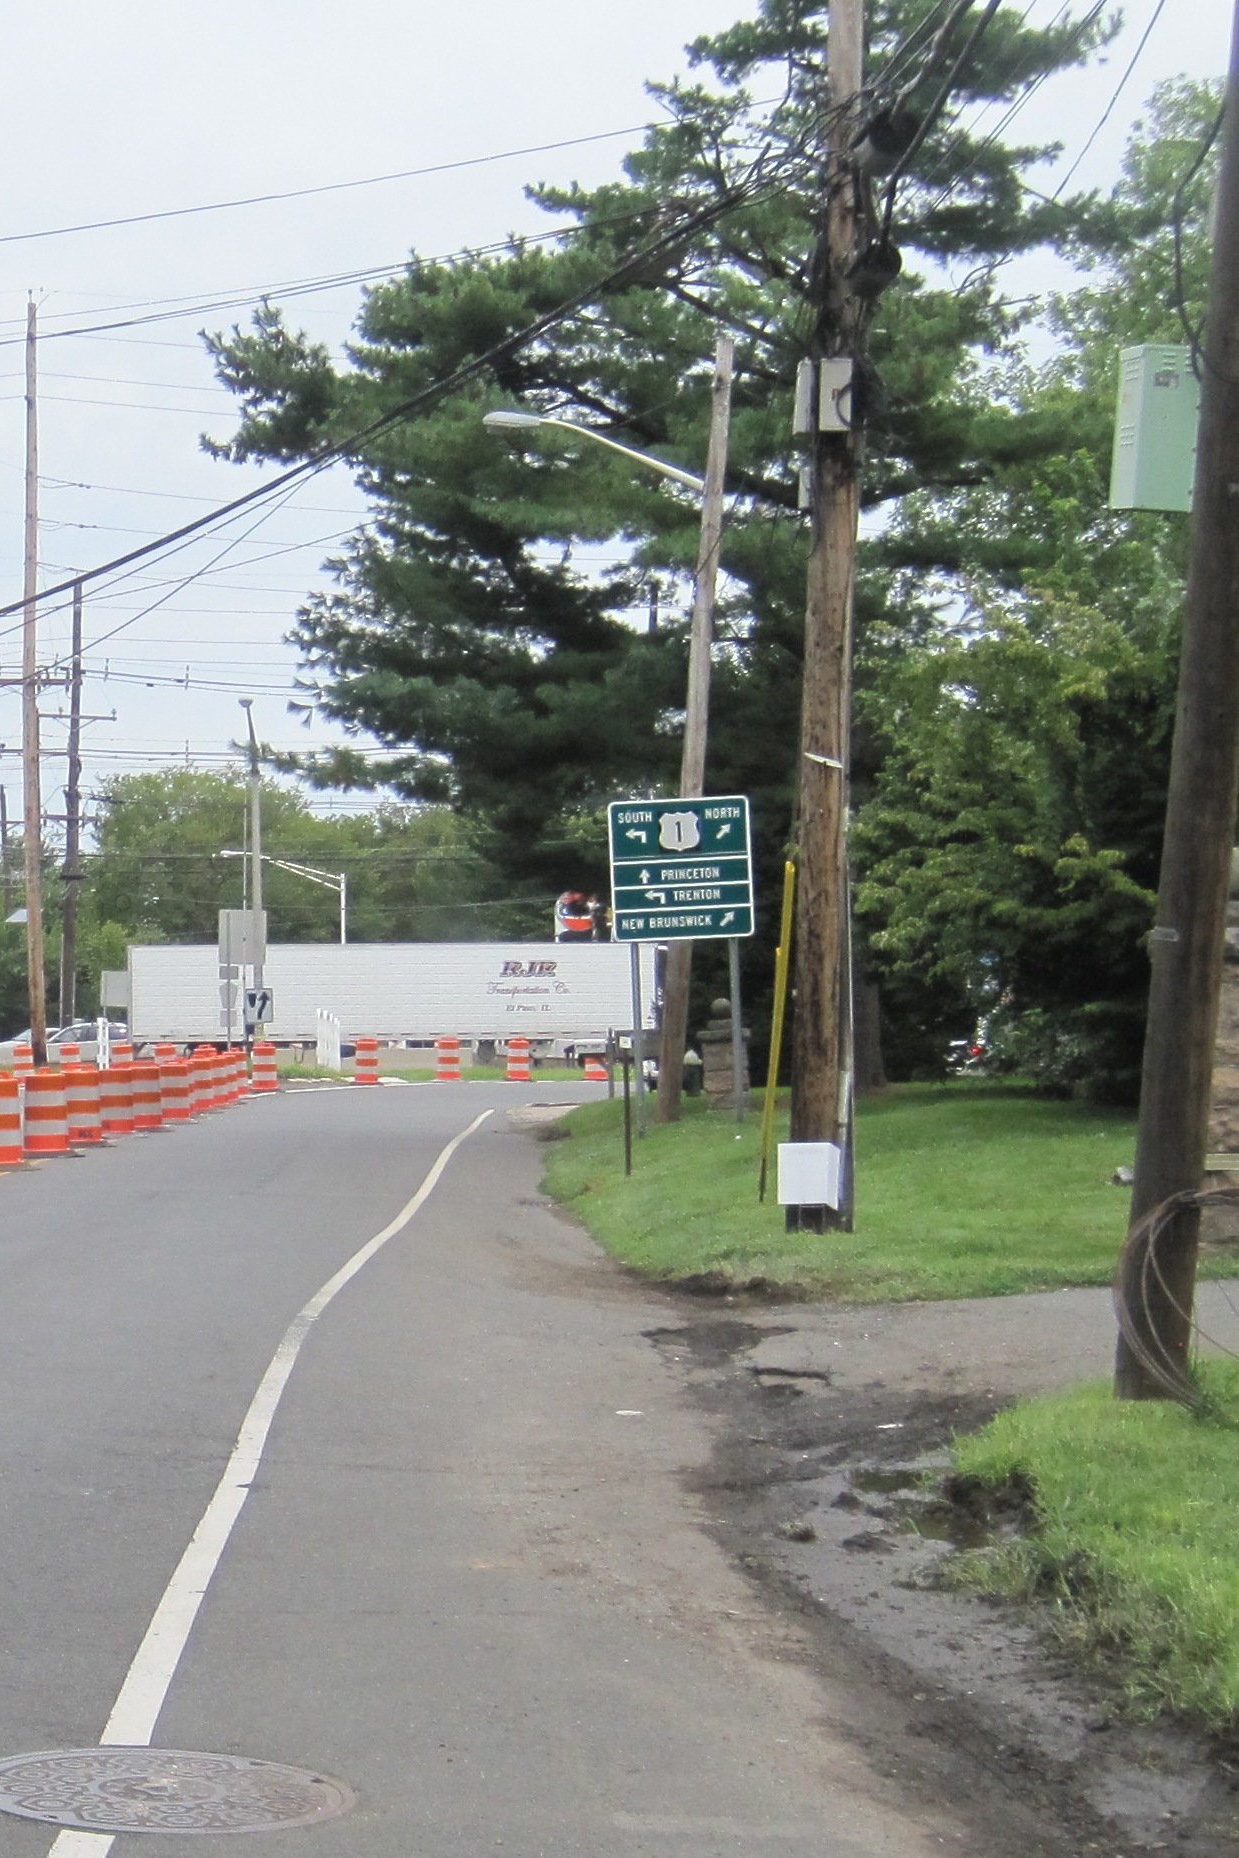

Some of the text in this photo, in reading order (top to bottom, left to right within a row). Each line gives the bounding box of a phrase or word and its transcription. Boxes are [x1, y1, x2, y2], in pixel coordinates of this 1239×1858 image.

[618, 811, 652, 824] SOUTH
[704, 807, 740, 819] NORTH
[674, 821, 682, 843] 1
[661, 867, 720, 881] PRINCETON
[673, 889, 721, 901] TRENTON
[622, 915, 712, 930] NEW BRUNSWICK
